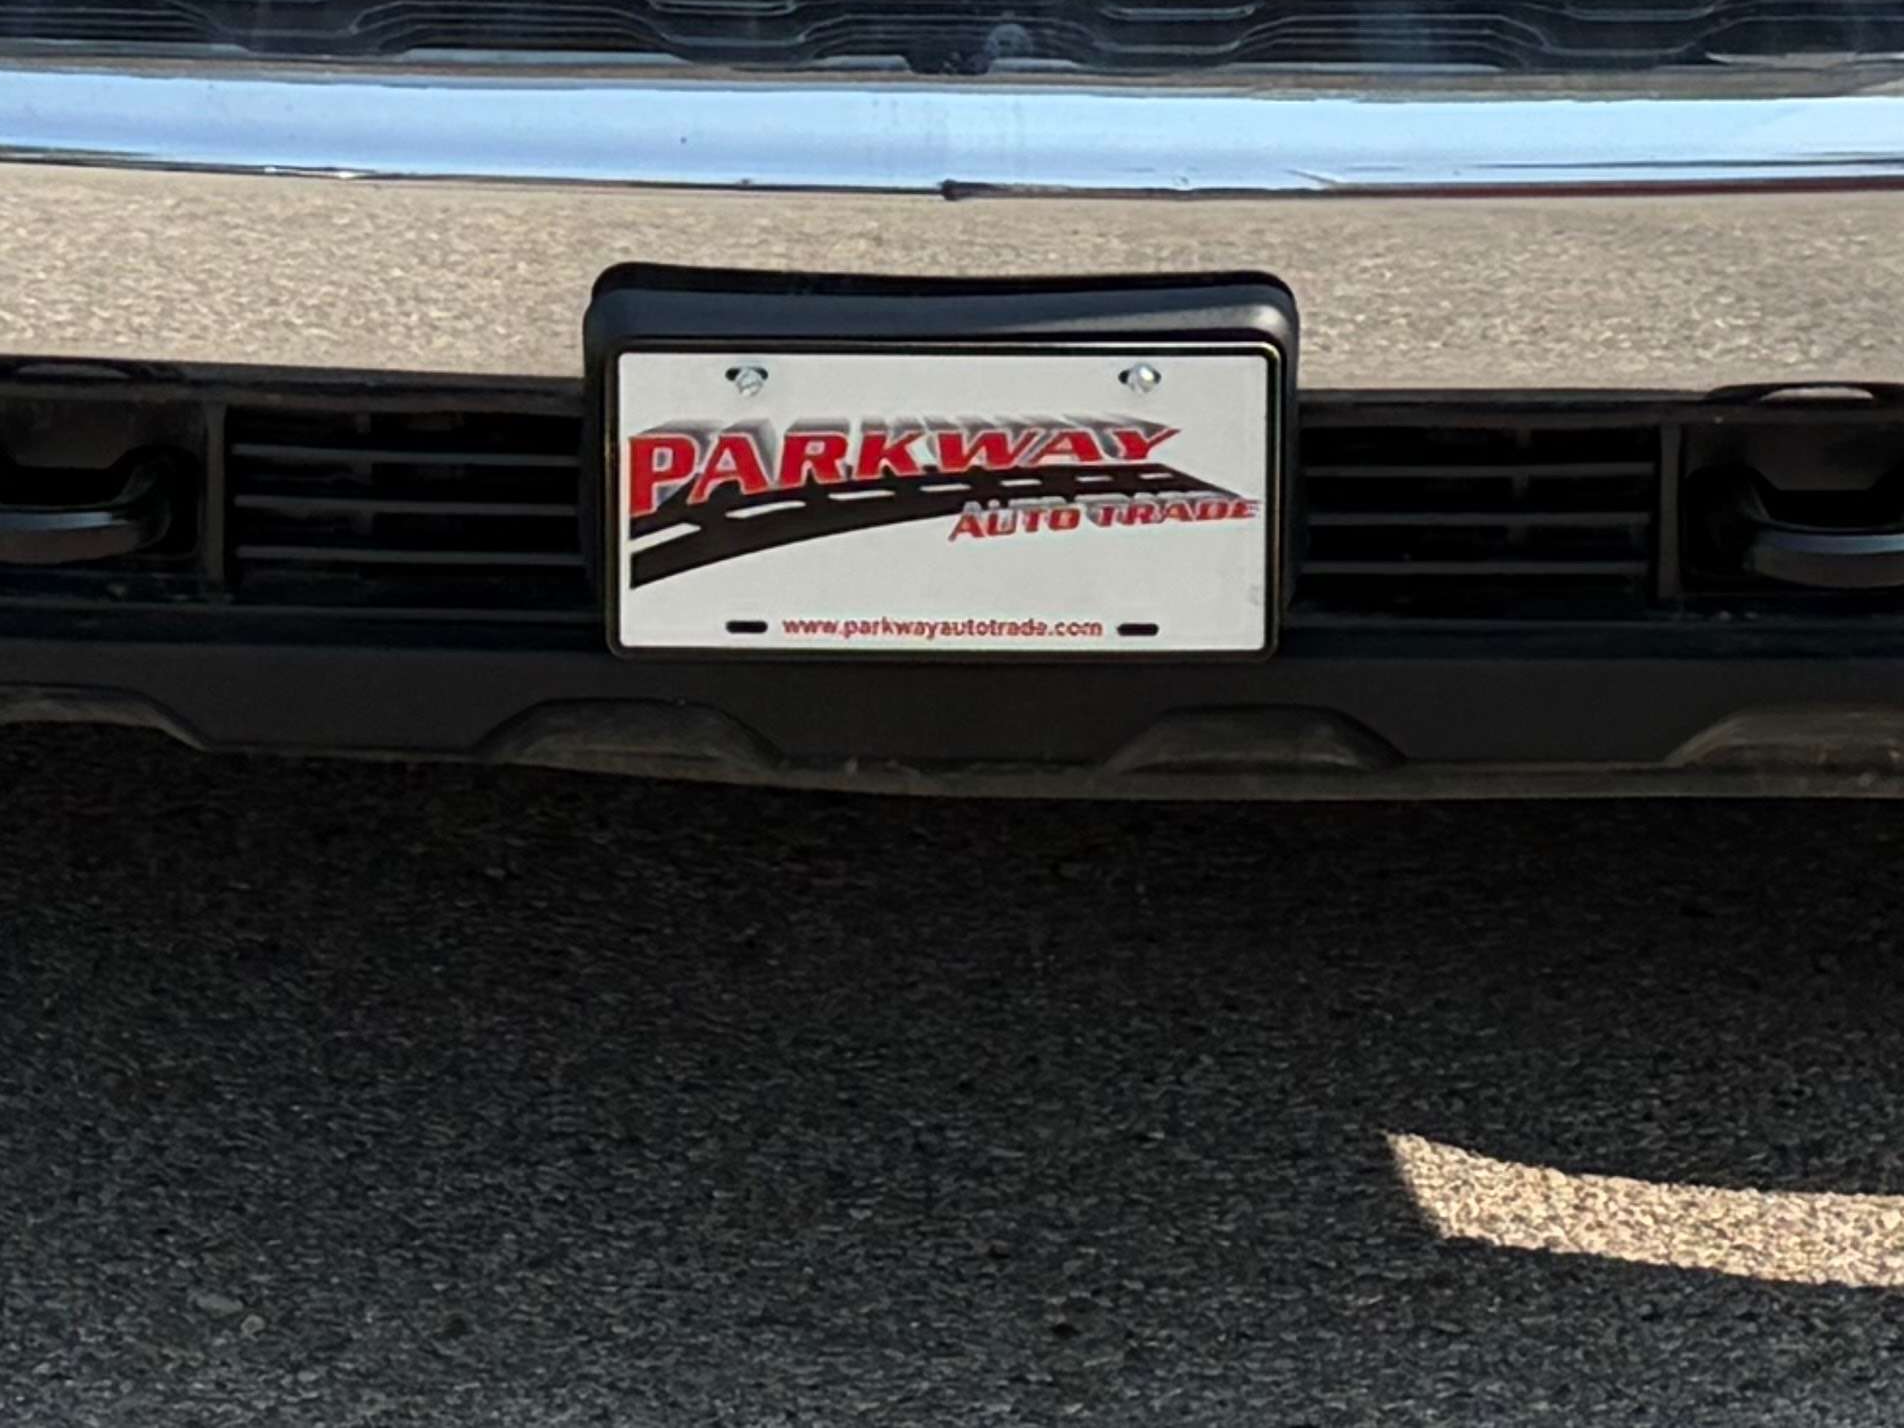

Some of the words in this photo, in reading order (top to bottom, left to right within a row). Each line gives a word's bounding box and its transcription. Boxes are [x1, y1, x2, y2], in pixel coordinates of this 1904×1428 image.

[628, 423, 1182, 519] PARKWAY
[947, 505, 1081, 542] AUTO
[1094, 498, 1261, 528] TRADE
[782, 617, 1104, 640] www.parkwayautotrade.com
